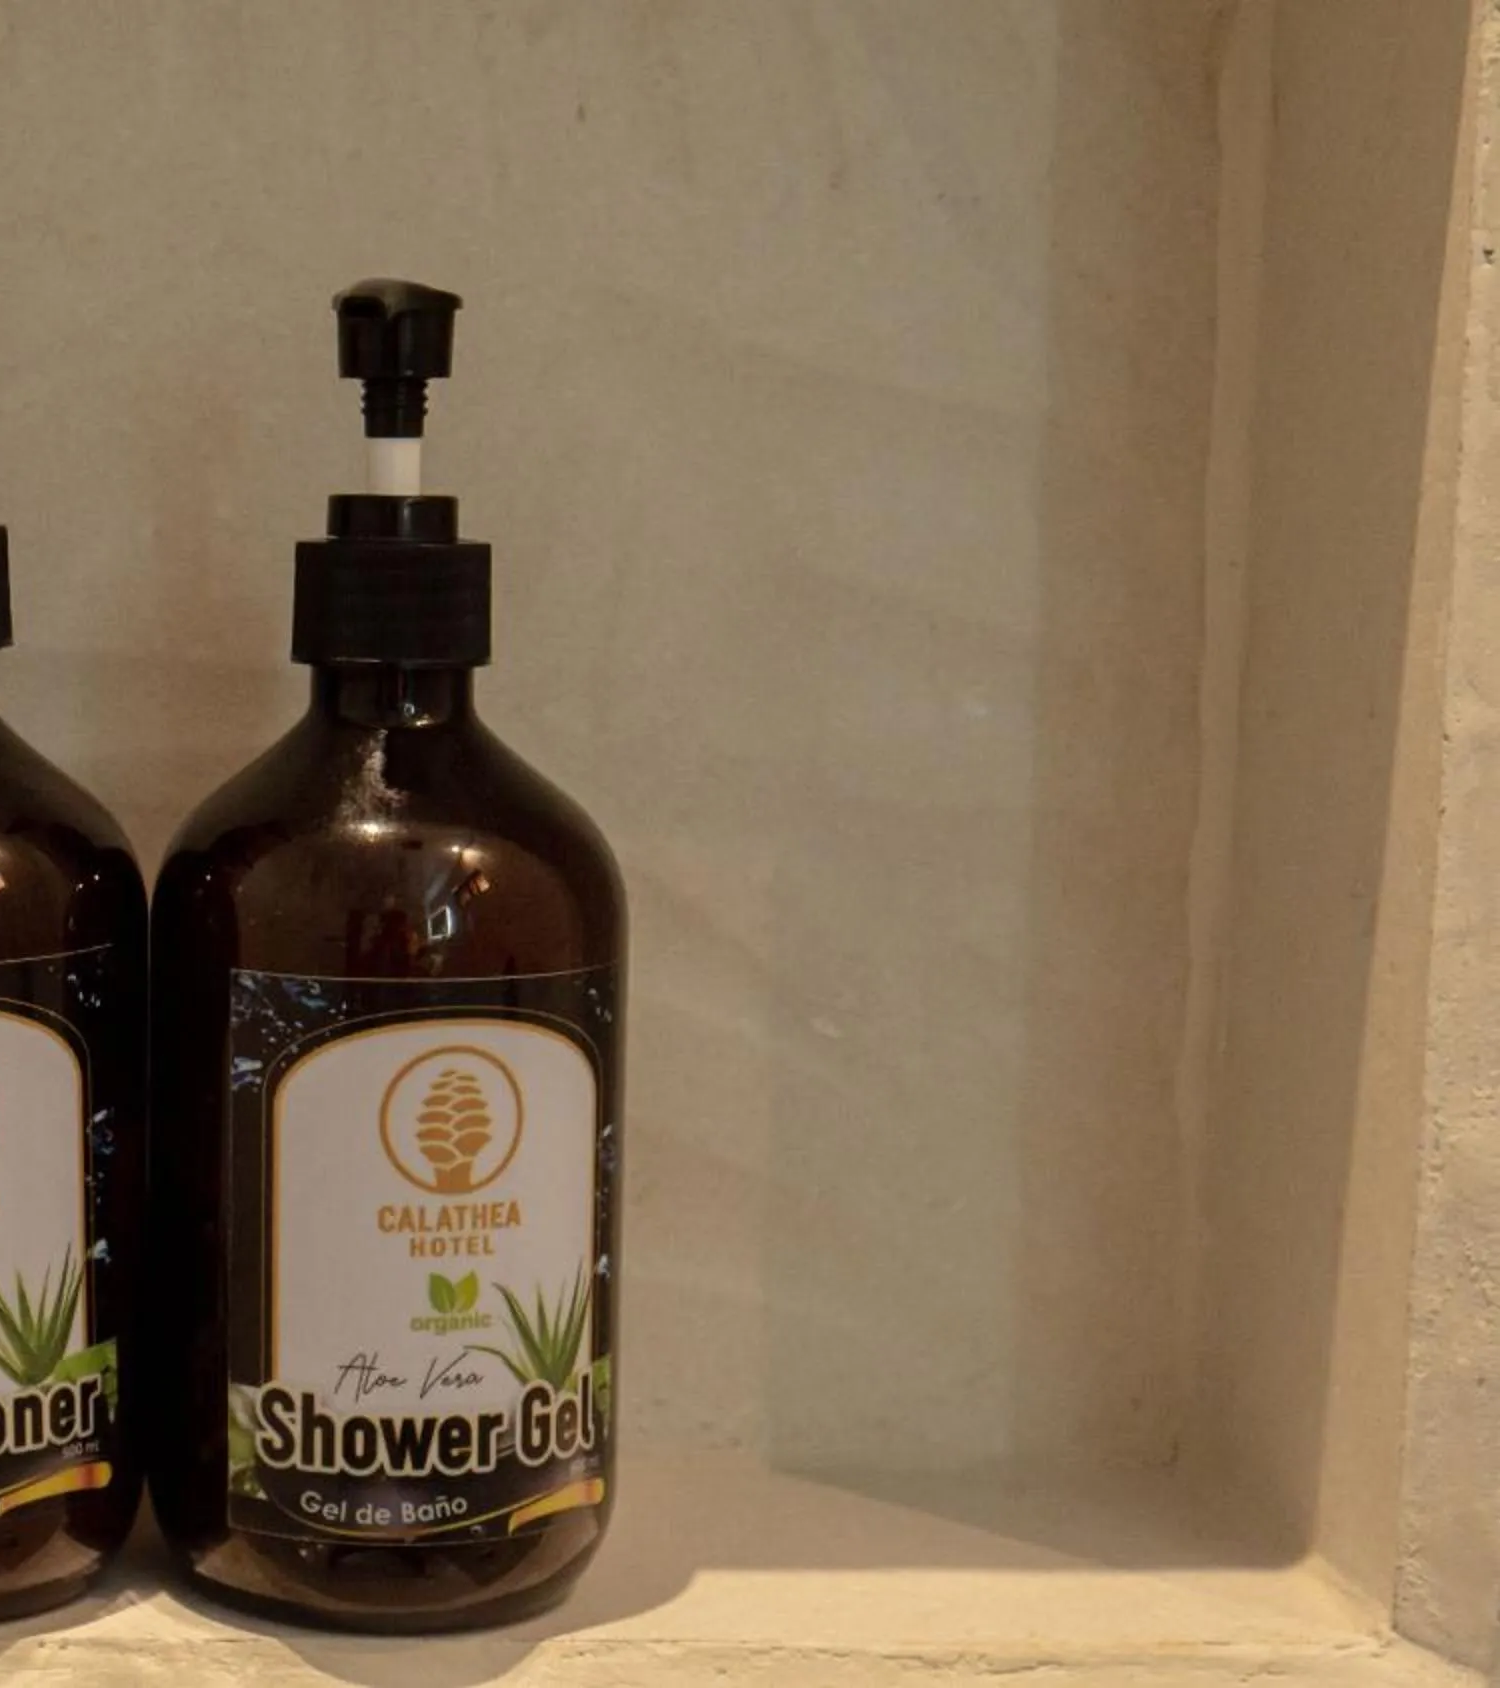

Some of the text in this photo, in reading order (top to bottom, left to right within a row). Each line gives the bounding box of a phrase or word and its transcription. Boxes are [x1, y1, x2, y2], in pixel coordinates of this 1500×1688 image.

[377, 1201, 521, 1233] CALATHEA
[408, 1236, 495, 1258] HOTEL
[409, 1312, 493, 1336] organic
[333, 1350, 484, 1403] Aloe Vera
[255, 1372, 595, 1477] Shower Gel
[299, 1490, 468, 1525] Gel de Baño
